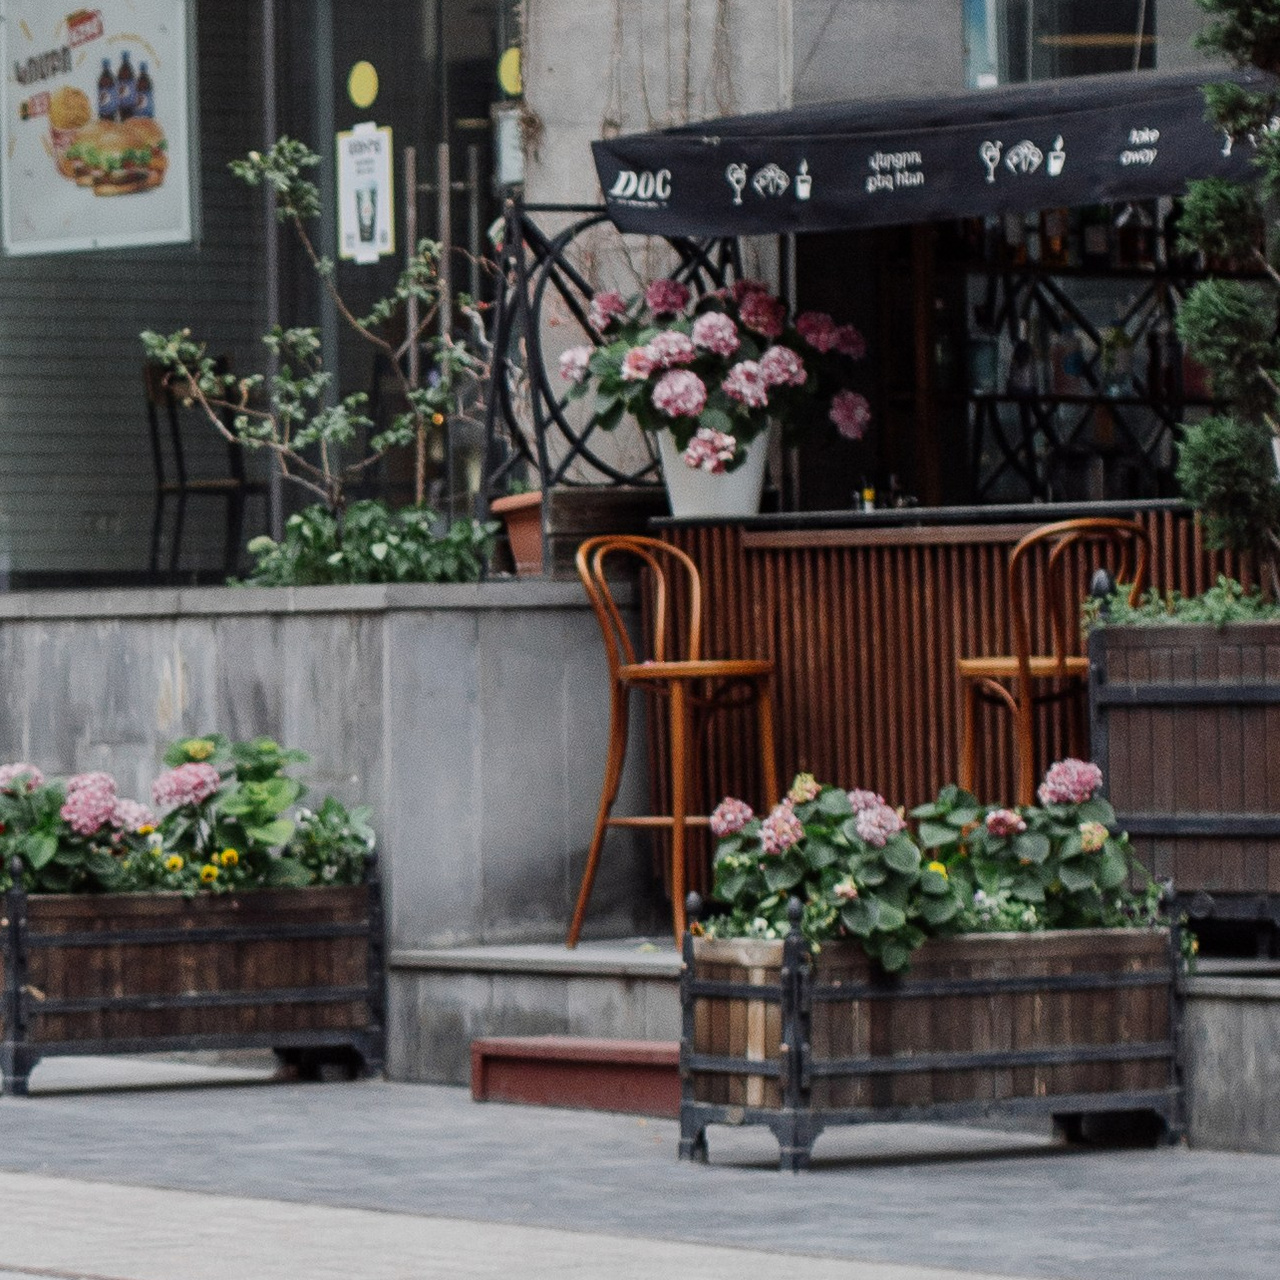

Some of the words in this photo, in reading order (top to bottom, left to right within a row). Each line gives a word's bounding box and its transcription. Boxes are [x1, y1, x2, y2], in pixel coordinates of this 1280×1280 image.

[1128, 126, 1160, 144] take
[1120, 147, 1158, 166] away
[608, 168, 672, 200] DOC
